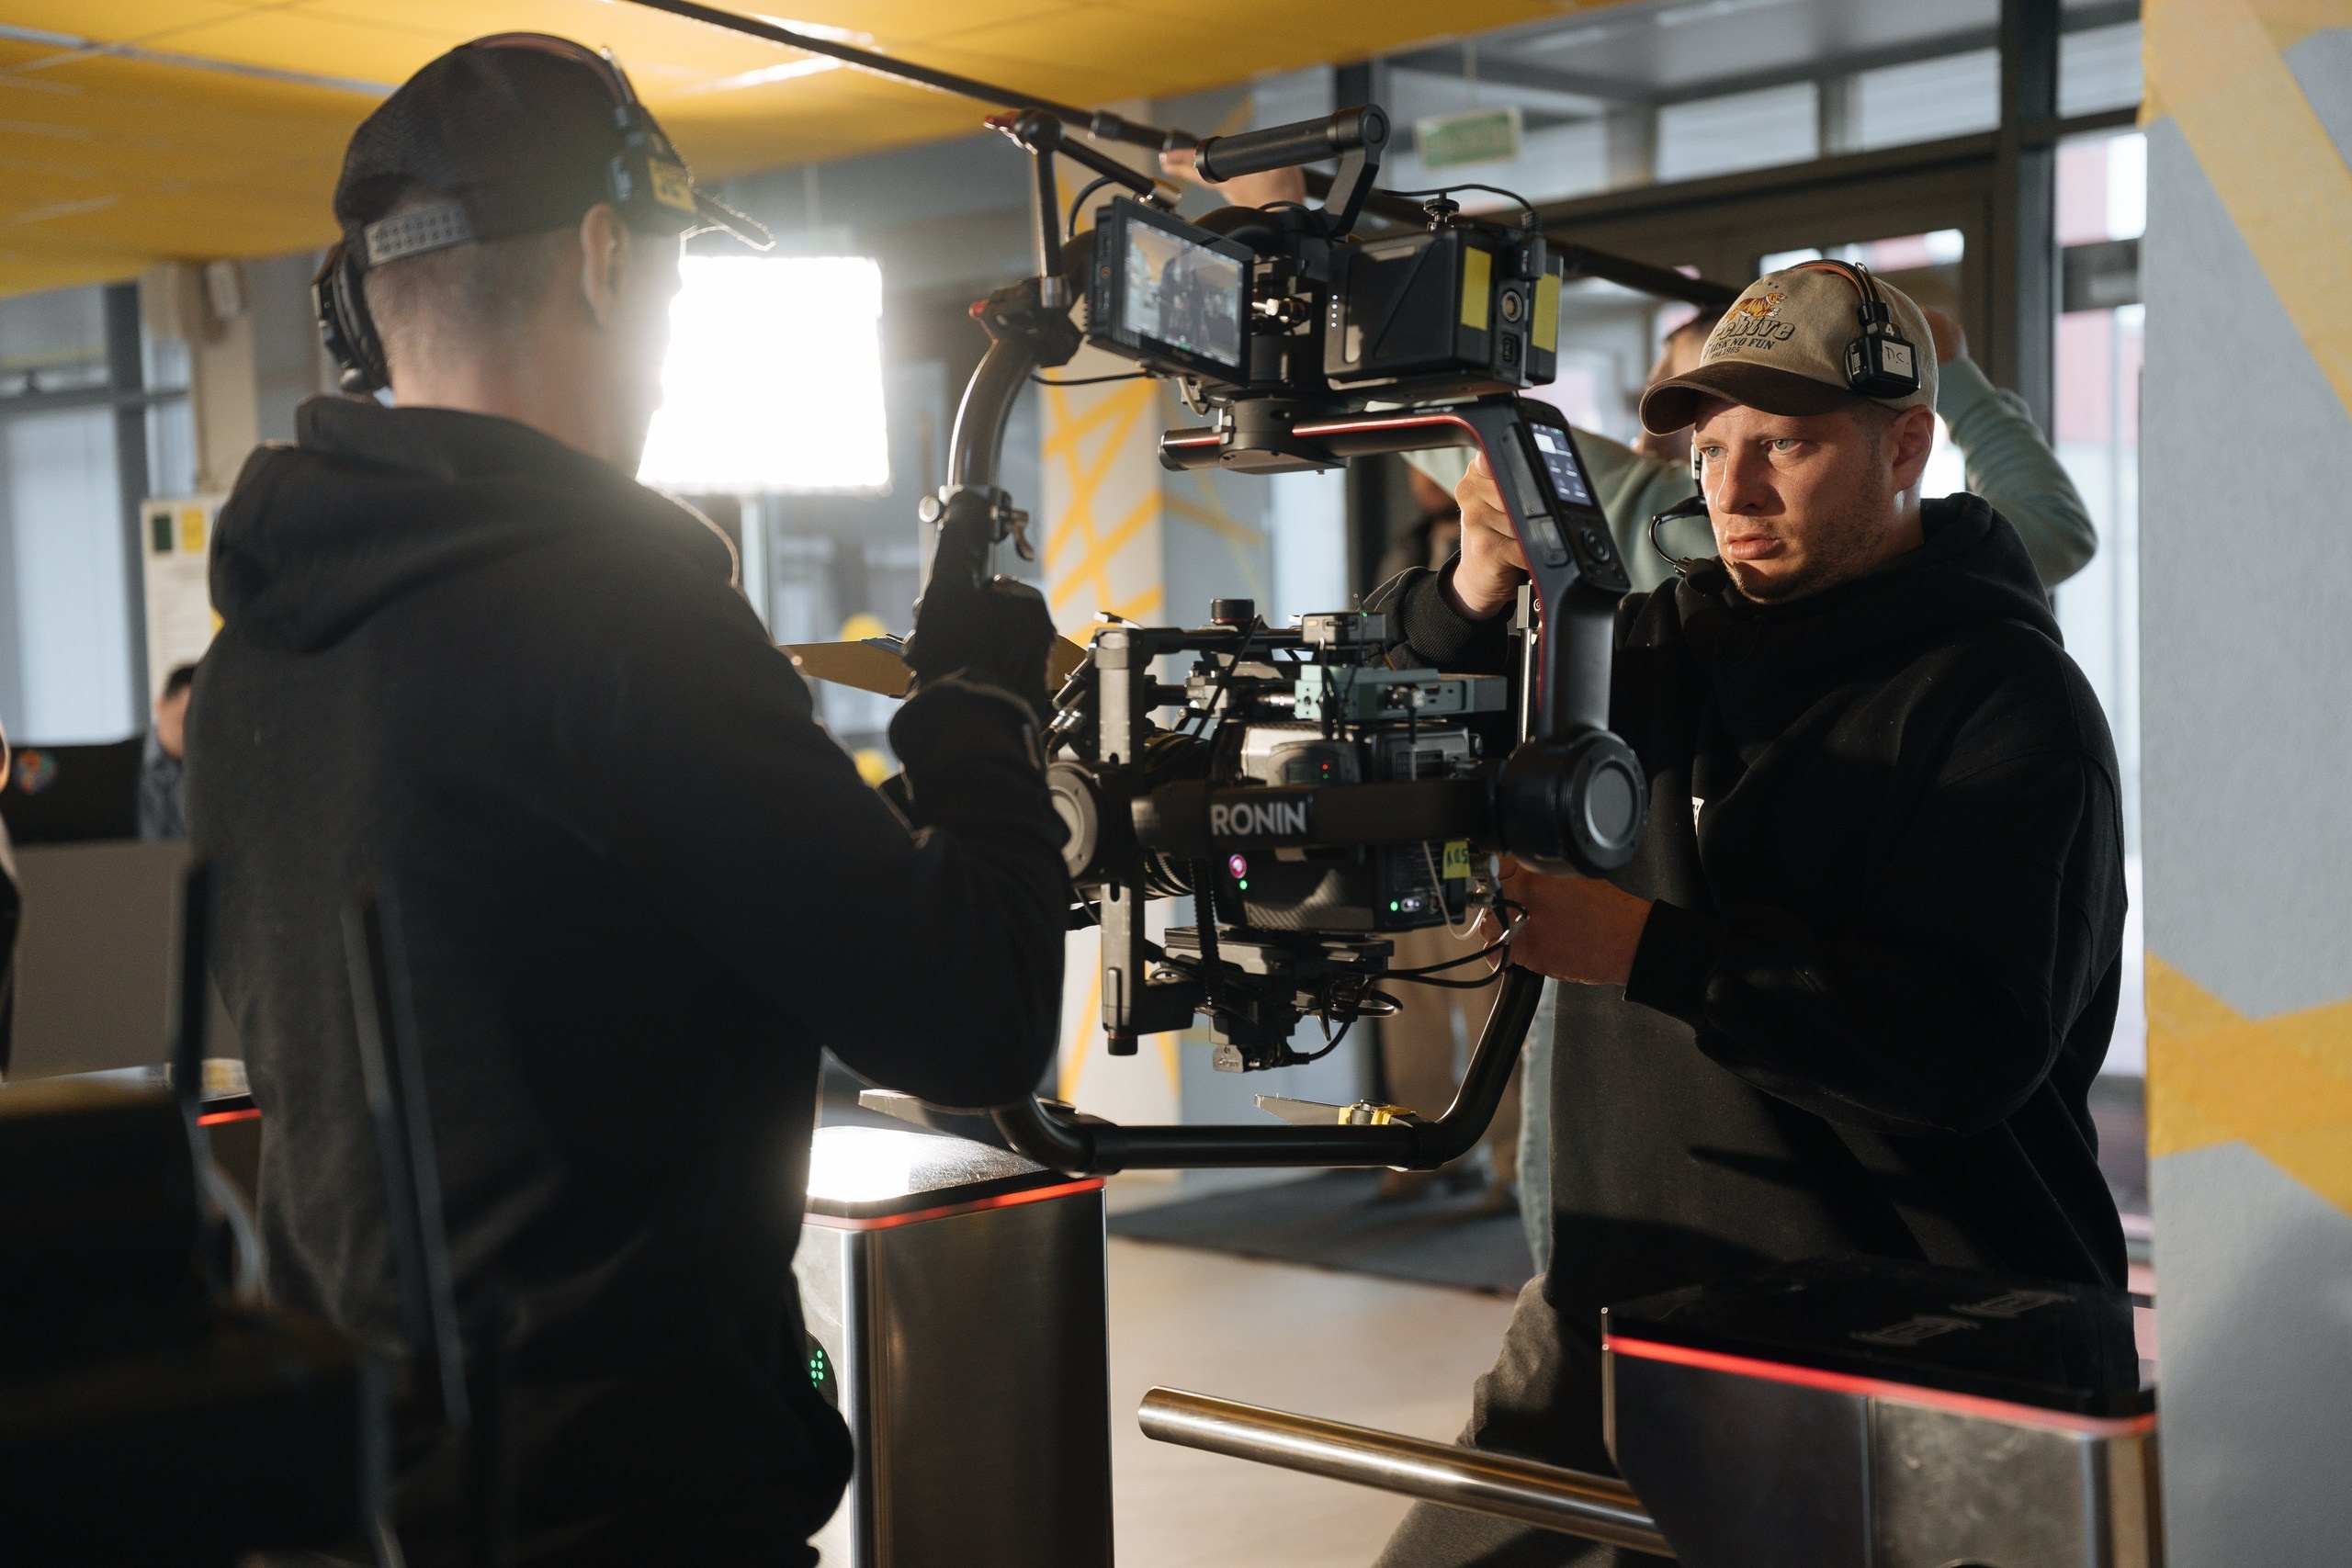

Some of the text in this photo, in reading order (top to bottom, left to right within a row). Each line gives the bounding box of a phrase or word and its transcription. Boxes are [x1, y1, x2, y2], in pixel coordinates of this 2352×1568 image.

[1885, 323, 1895, 336] 4
[1730, 337, 1747, 346] NO
[1747, 338, 1776, 350] FUN
[1210, 800, 1306, 836] RONIN
